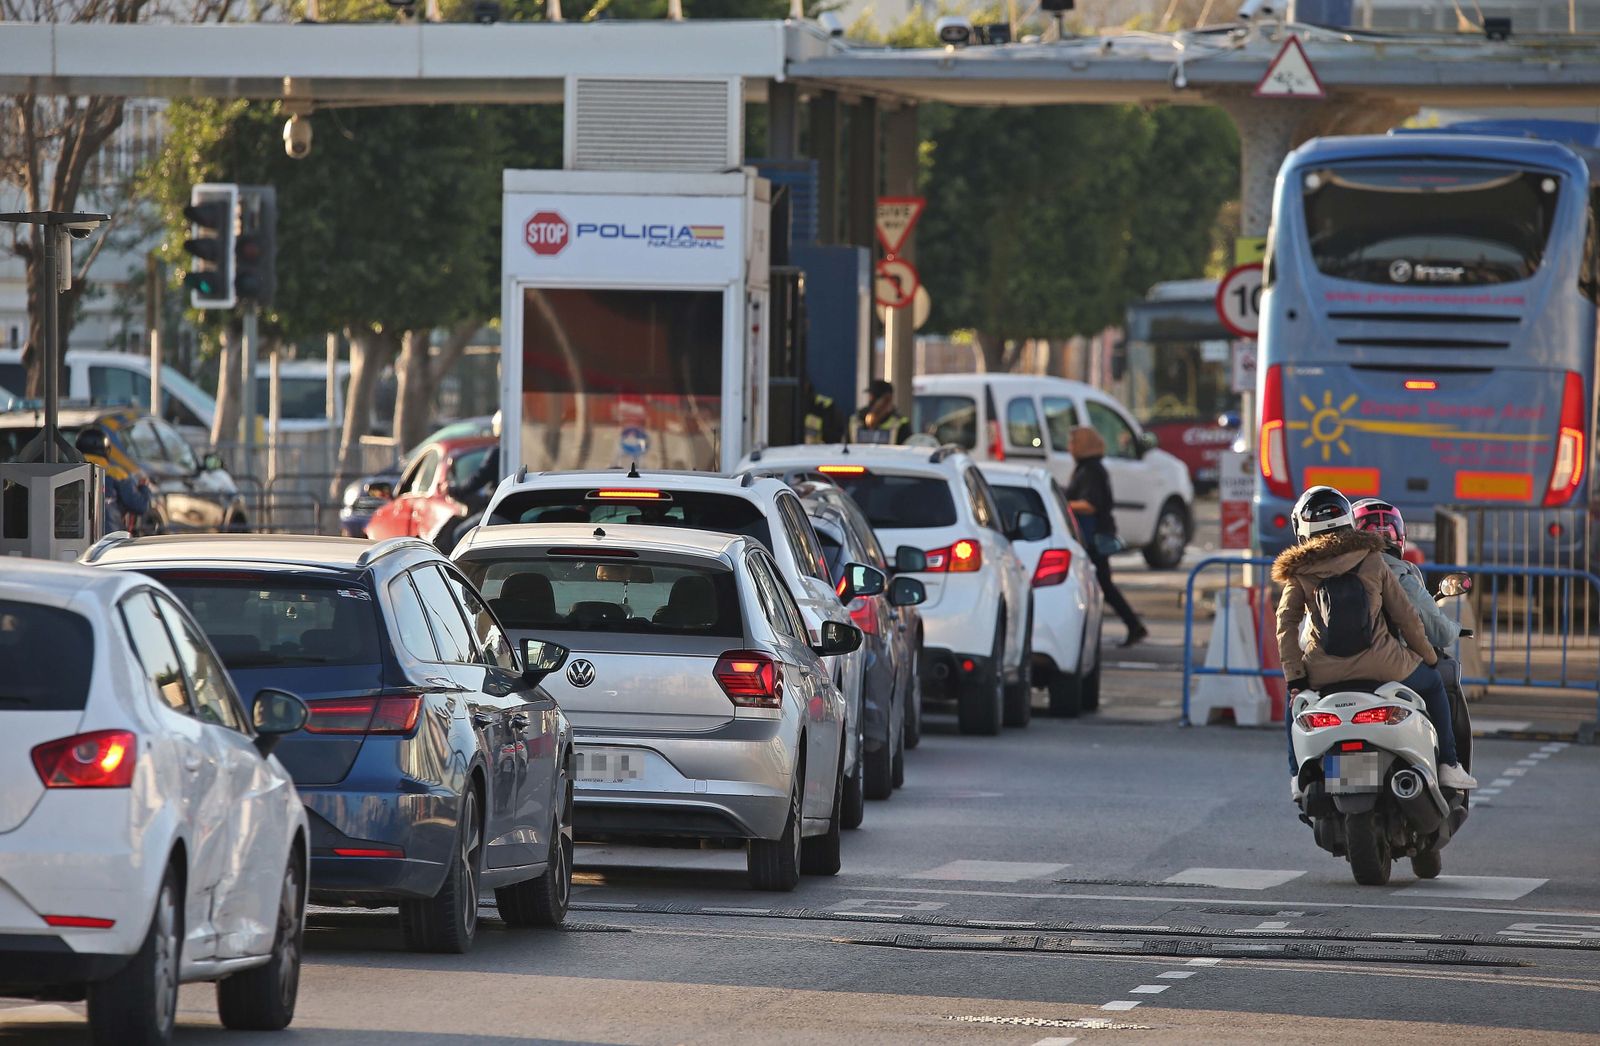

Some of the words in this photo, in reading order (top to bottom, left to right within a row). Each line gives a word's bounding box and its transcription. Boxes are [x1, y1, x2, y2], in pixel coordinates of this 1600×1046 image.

[527, 222, 567, 244] STOP
[577, 224, 694, 239] POLICIA
[647, 238, 724, 249] NACIONAL
